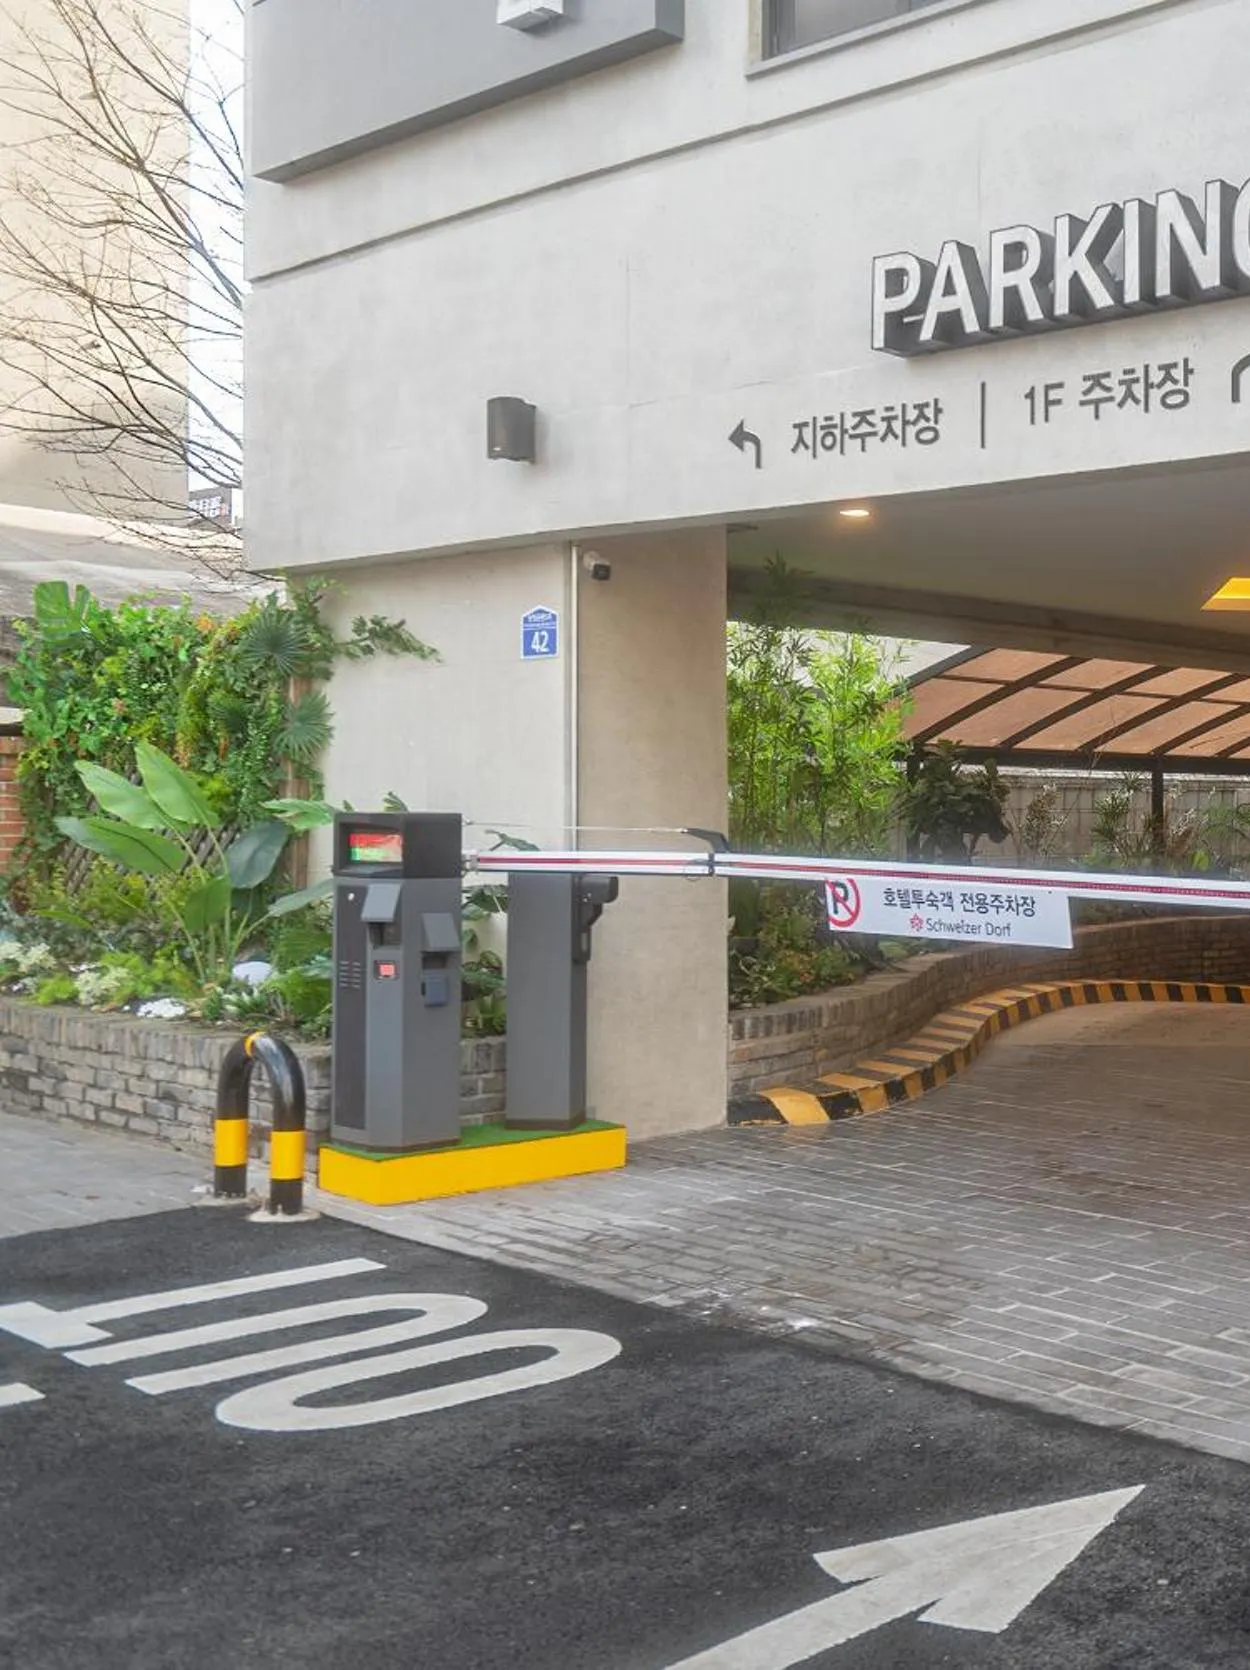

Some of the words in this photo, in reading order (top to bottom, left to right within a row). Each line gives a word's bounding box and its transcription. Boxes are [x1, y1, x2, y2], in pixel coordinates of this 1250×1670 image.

[1024, 381, 1066, 425] 1F
[1078, 357, 1195, 421] 주차장
[791, 398, 944, 459] 지하주차장
[530, 631, 551, 653] 42
[882, 887, 954, 913] 호텔투숙객
[960, 891, 1037, 918] 전용주차장
[926, 917, 982, 936] Schweizer
[986, 921, 1013, 937] Dorf
